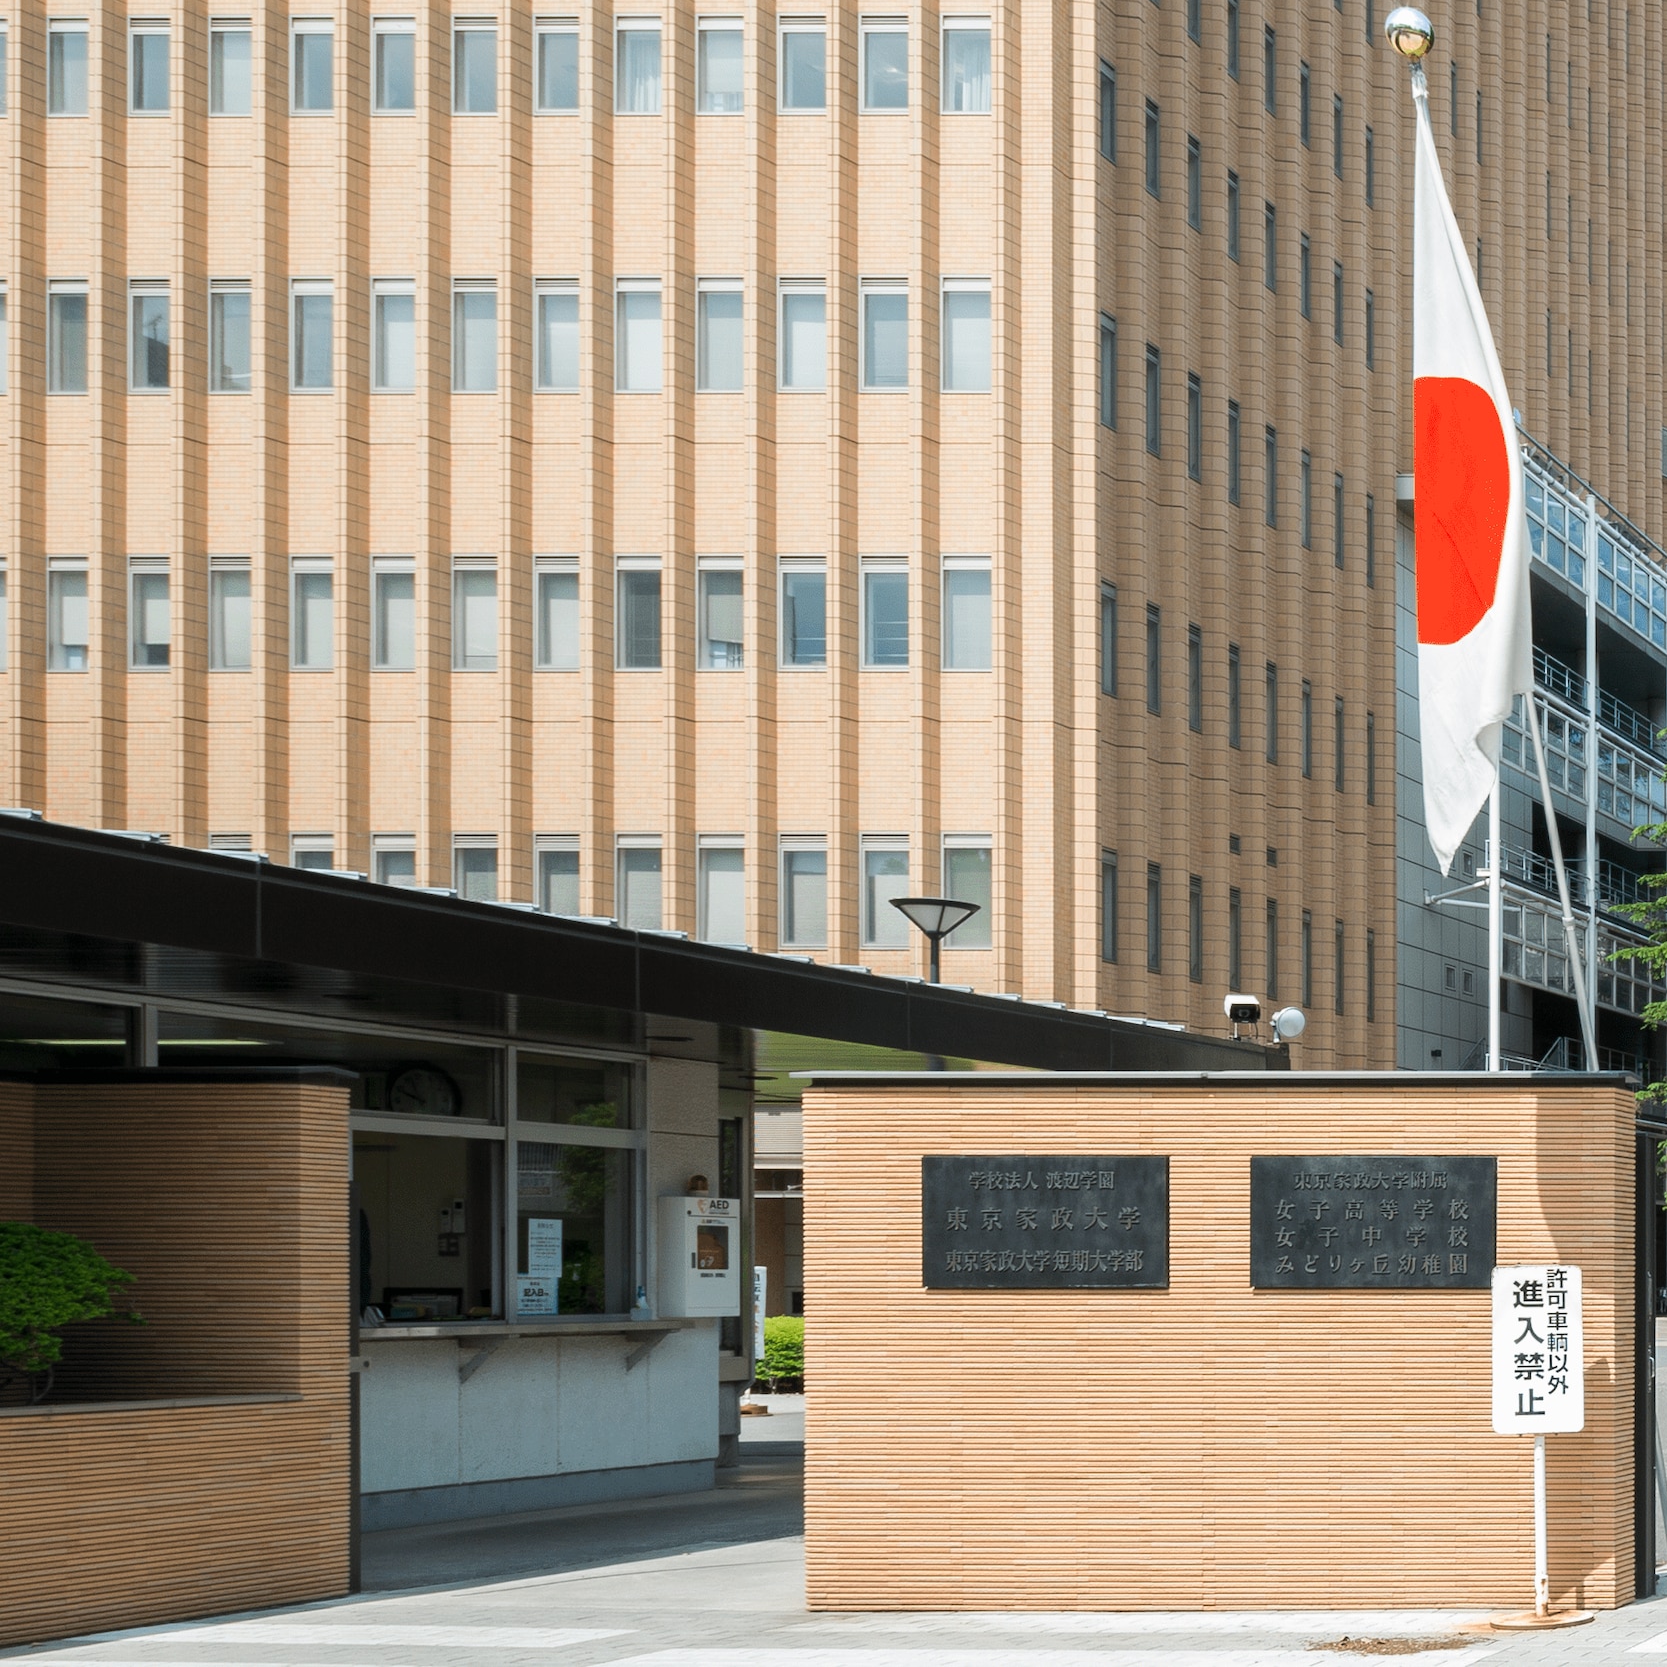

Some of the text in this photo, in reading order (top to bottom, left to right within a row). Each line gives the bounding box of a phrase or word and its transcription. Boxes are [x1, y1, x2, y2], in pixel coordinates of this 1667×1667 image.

[968, 1171, 1115, 1190] 学校法人 渡辺学園
[1293, 1171, 1448, 1191] 東京家政大学附属
[709, 1199, 729, 1210] AED
[1274, 1199, 1469, 1221] 女子高等学校
[946, 1206, 1141, 1232] 東京家政大学
[1274, 1226, 1469, 1248] 女子中学校
[945, 1249, 1144, 1273] 東京家政大学短期大学部
[1513, 1280, 1545, 1416] 進入禁止
